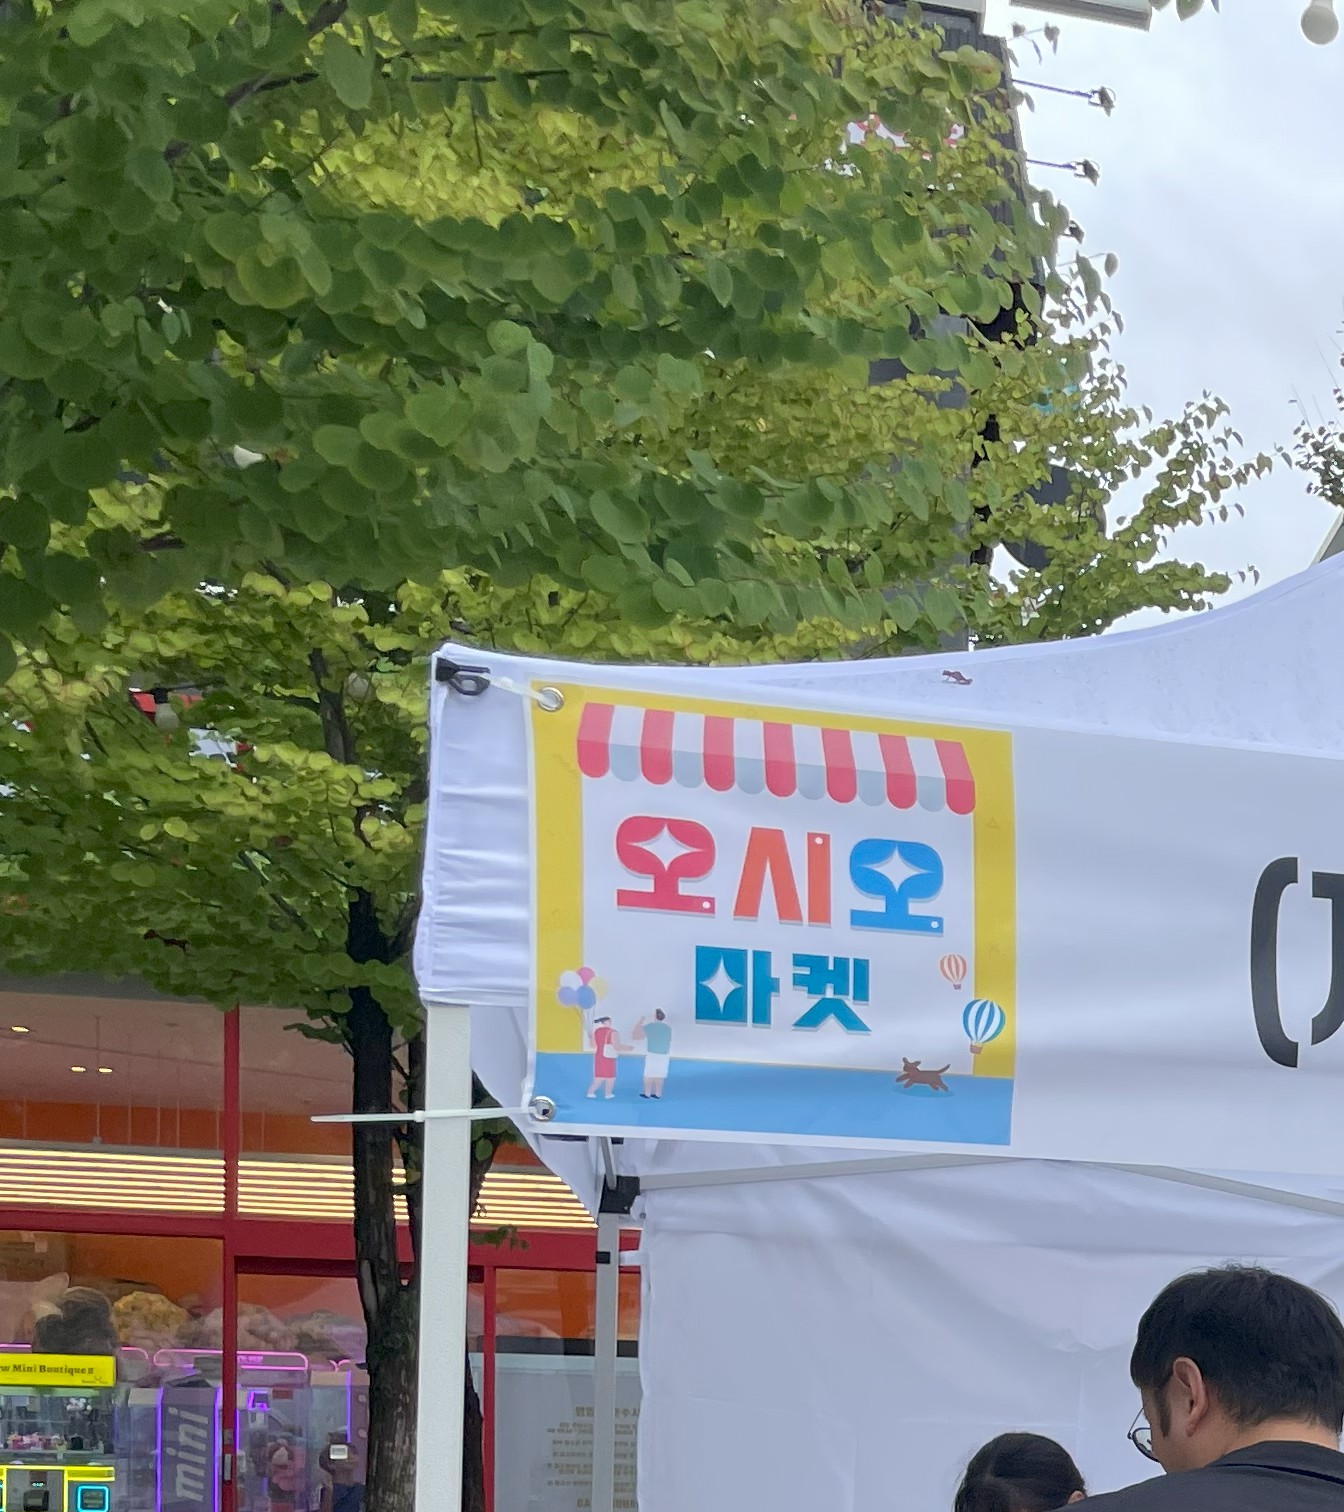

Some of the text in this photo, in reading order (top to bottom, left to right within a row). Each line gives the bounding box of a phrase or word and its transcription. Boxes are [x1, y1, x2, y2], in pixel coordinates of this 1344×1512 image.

[614, 815, 945, 936] 오시오
[694, 945, 872, 1033] 마켓
[13, 1364, 37, 1373] Mini
[168, 1406, 209, 1502] mini
